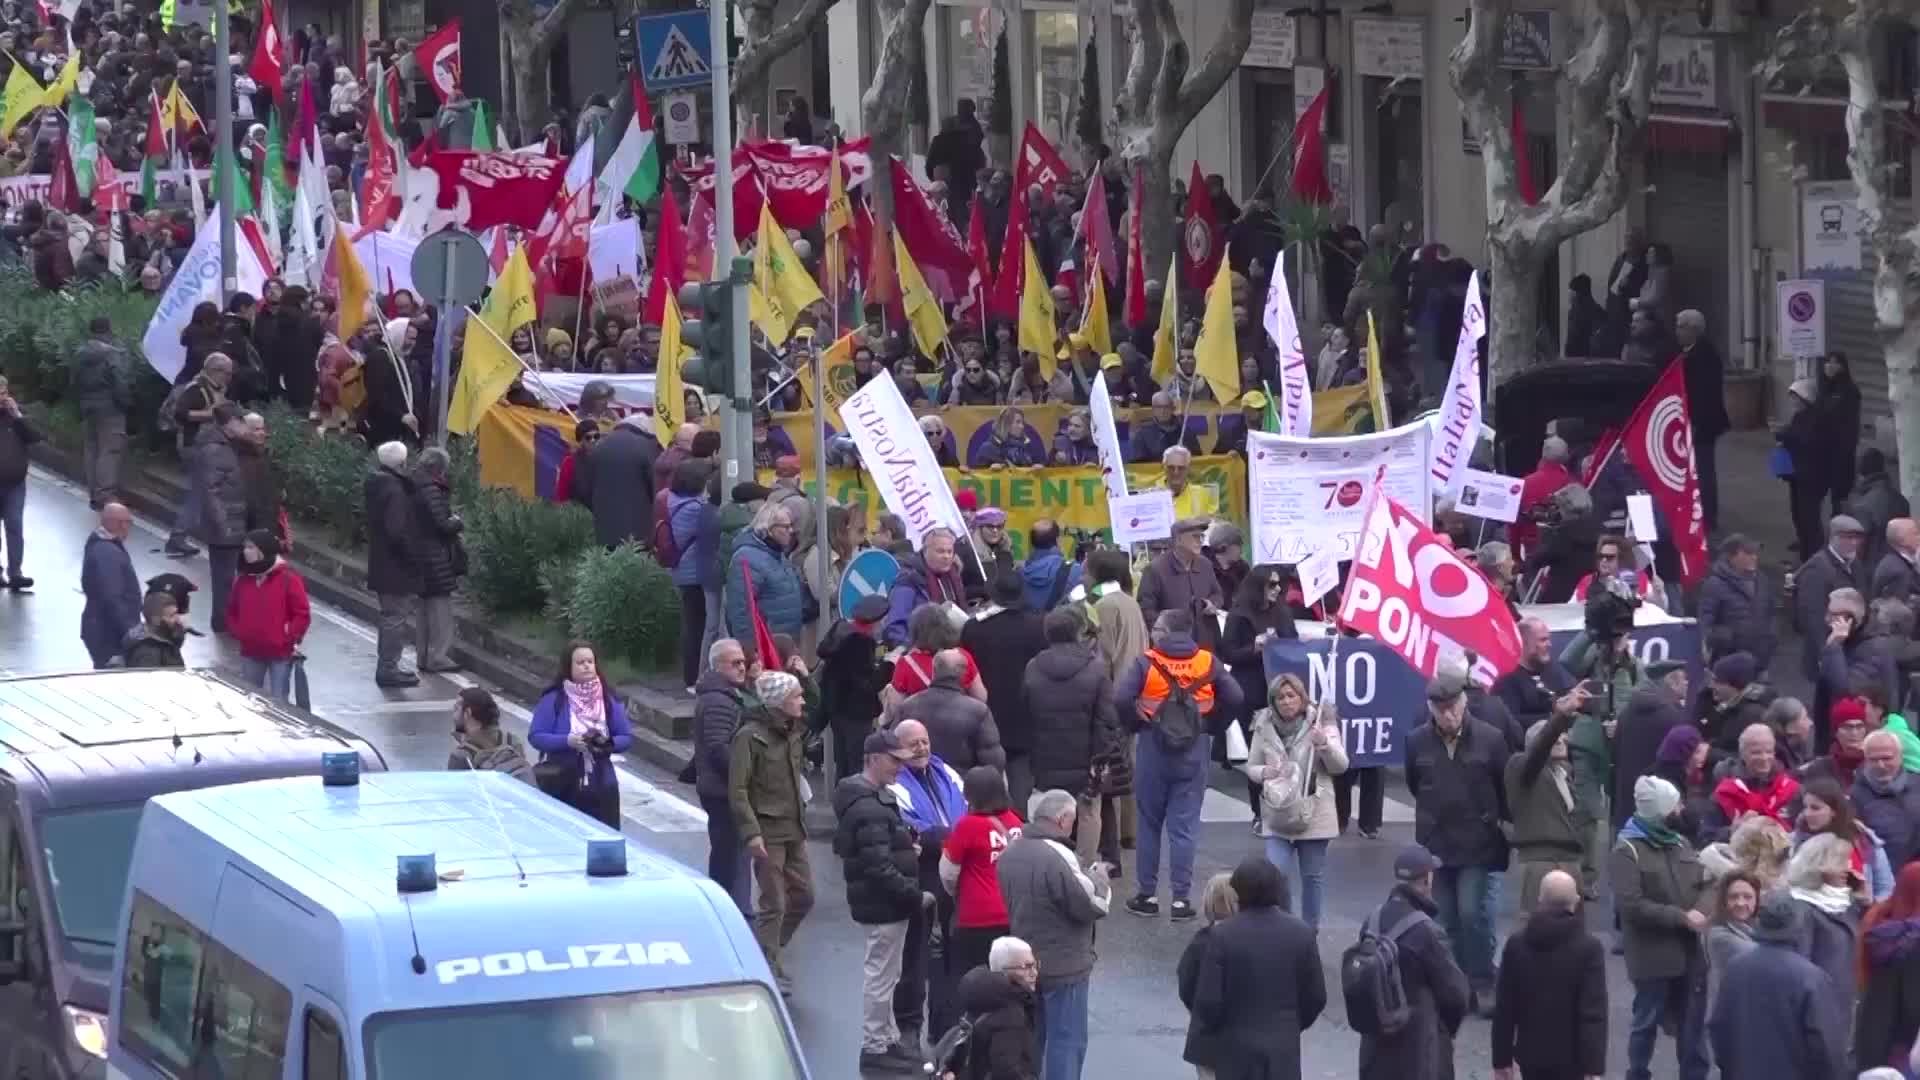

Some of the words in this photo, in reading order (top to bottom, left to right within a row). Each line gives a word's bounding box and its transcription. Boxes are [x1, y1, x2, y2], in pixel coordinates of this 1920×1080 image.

[1360, 490, 1489, 618] NO
[1306, 651, 1377, 706] NO
[435, 941, 692, 985] POLIZIA
